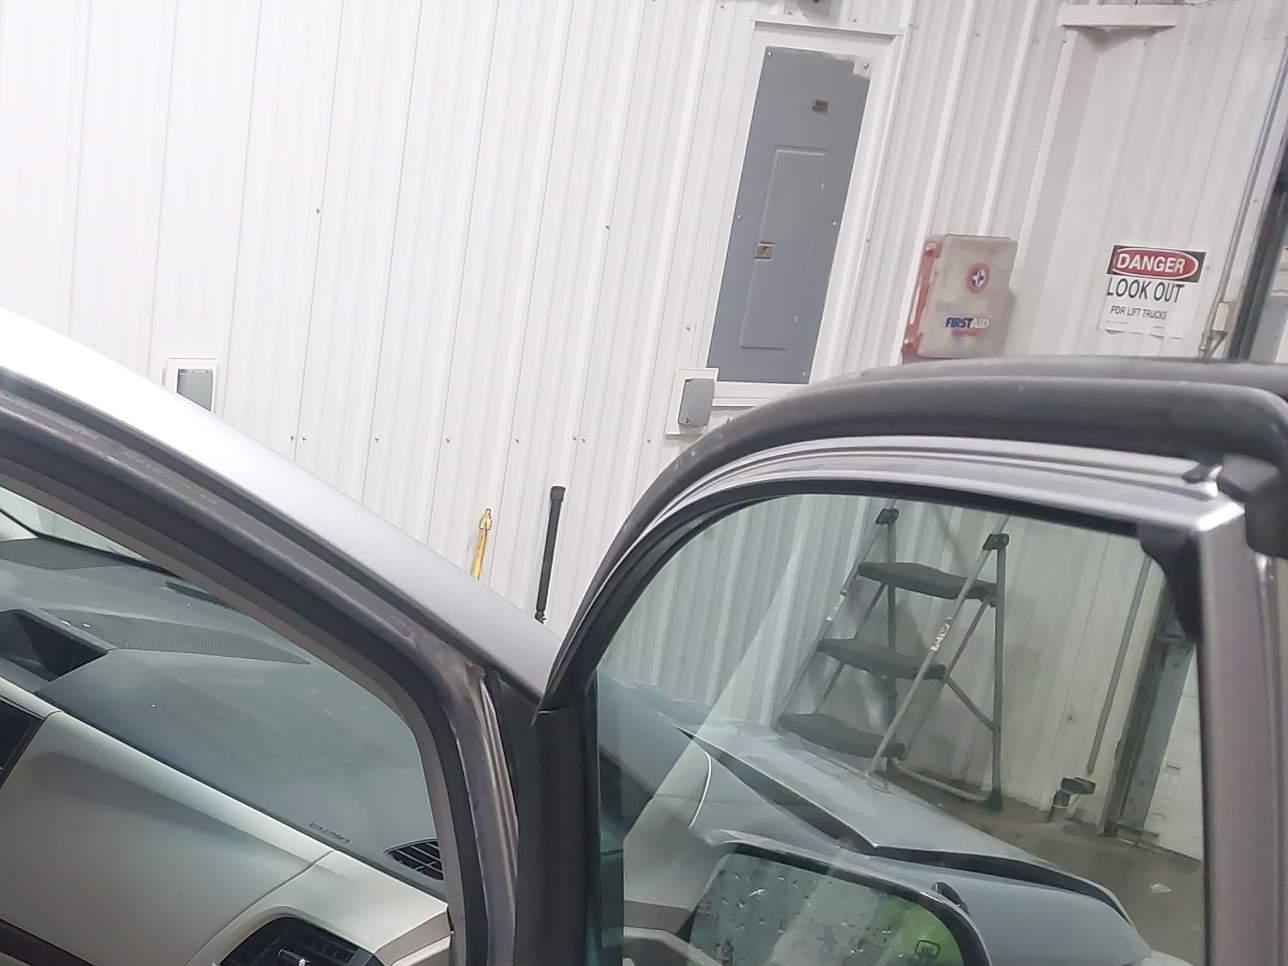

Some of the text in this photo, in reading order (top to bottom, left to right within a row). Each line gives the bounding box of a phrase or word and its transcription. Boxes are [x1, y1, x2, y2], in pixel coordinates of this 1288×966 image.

[1116, 253, 1186, 274] DANGER
[1106, 277, 1185, 303] LOOK OUT
[1110, 305, 1127, 315] FOR
[1127, 306, 1142, 317] LIFT
